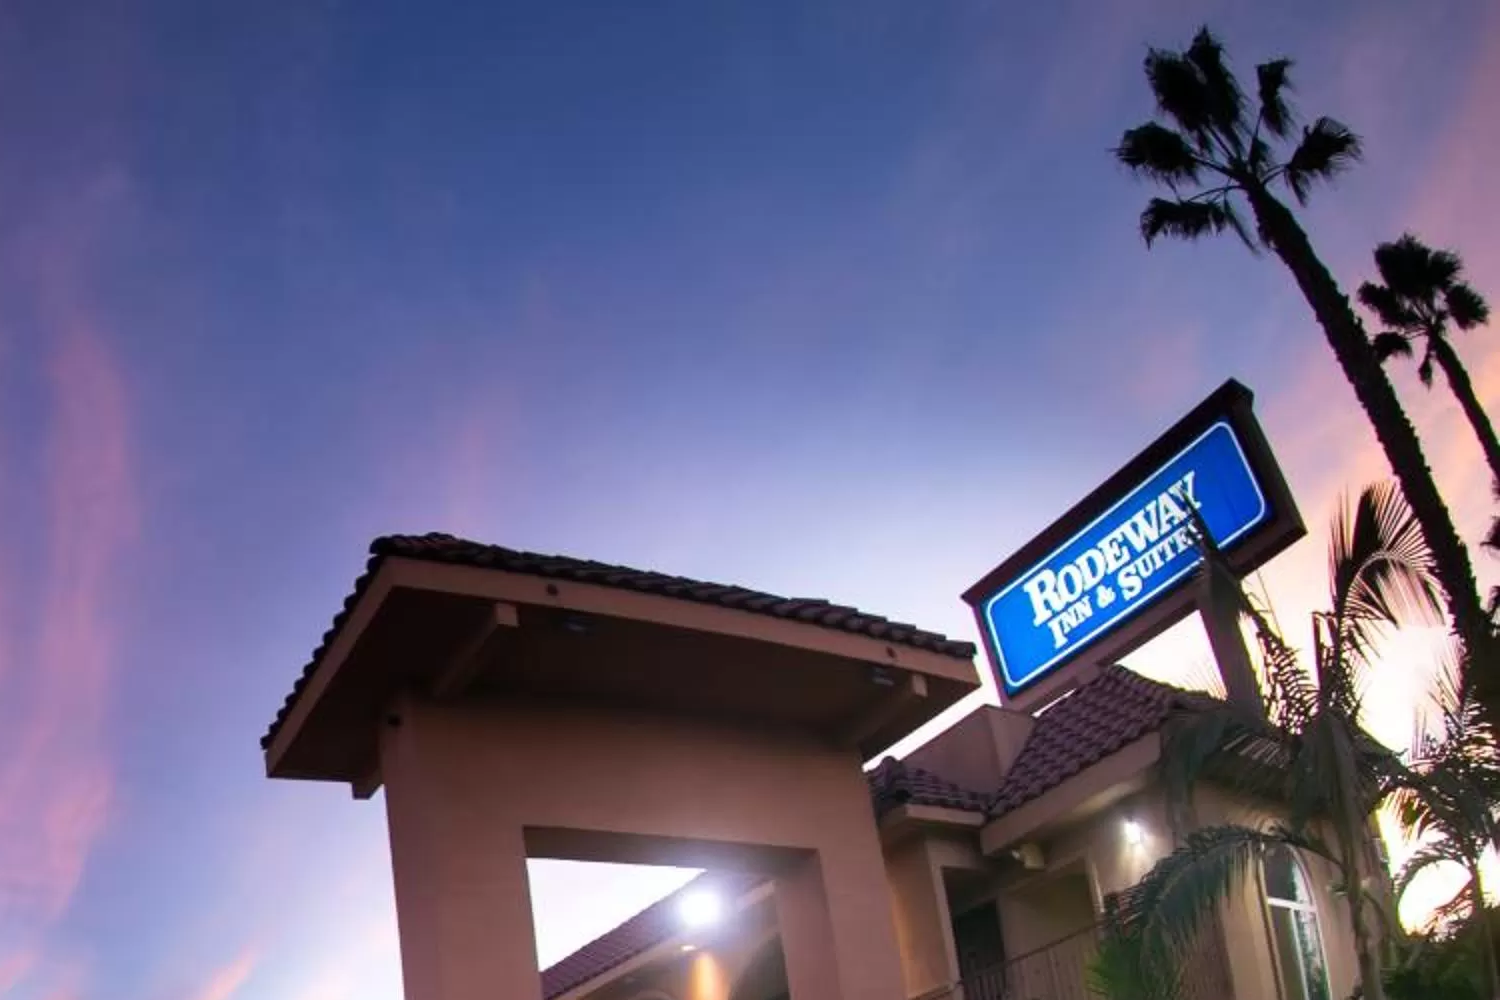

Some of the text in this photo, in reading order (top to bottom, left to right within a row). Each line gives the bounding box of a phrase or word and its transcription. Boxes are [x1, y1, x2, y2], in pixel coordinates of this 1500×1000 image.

[1022, 471, 1202, 628] RODEWAY
[1046, 594, 1094, 650] INN
[1096, 584, 1117, 609] &
